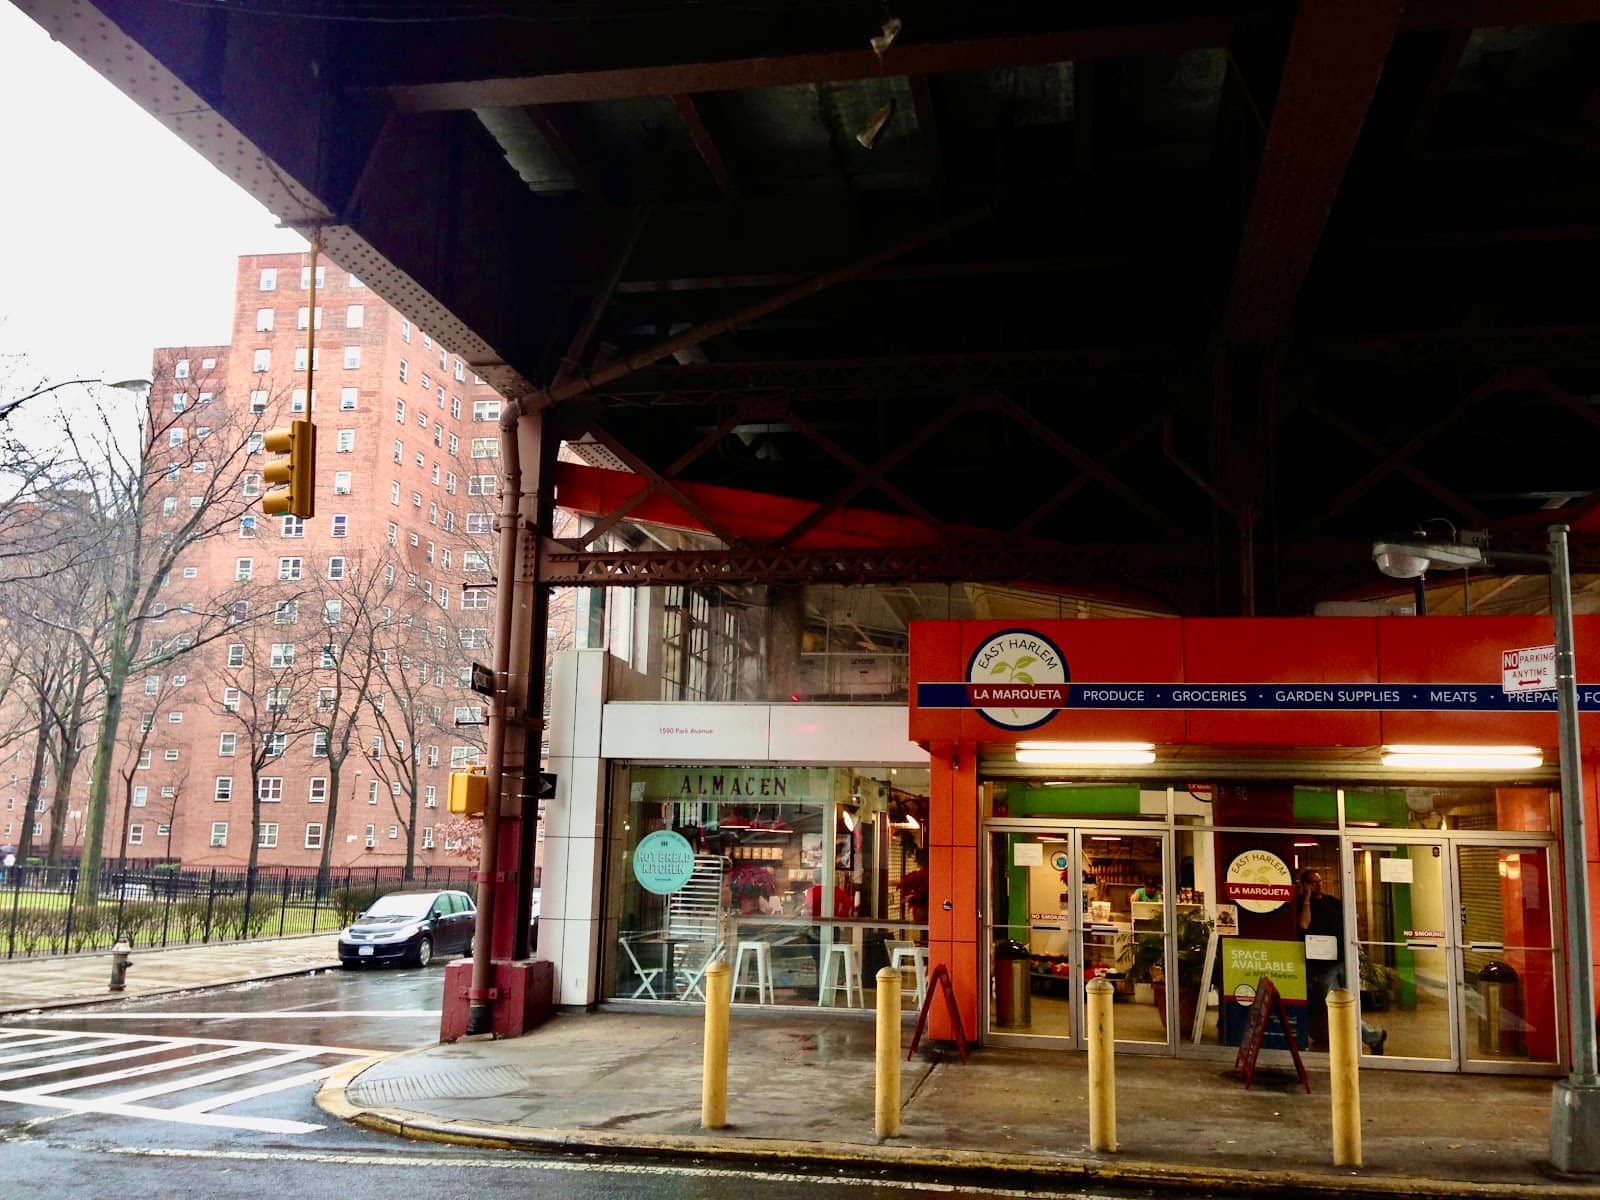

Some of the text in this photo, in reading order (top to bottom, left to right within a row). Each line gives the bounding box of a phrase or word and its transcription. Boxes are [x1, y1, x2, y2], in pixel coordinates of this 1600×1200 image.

[978, 639, 1058, 670] EAST HARLEM
[1504, 652, 1556, 668] NO PARKING
[1512, 667, 1549, 679] ANYTIME
[973, 689, 1062, 700] LA MARQUETA
[1083, 690, 1145, 701] PRODUCE
[1172, 690, 1247, 702] GROCERIES
[1275, 690, 1334, 702] GARDEN
[1337, 690, 1400, 702] SUPPLIES
[1430, 691, 1478, 703] MEATS
[1507, 691, 1580, 703] PREPAR
[675, 727, 688, 735] Park
[690, 727, 713, 735] Avenue
[680, 775, 787, 797] ALMACEN
[641, 863, 685, 875] KITCHEN
[1231, 854, 1287, 876] EAST HARLEM
[1229, 886, 1290, 896] LA MARQUETA
[1231, 950, 1268, 961] SPACE
[1231, 959, 1294, 972] AVAILABLE
